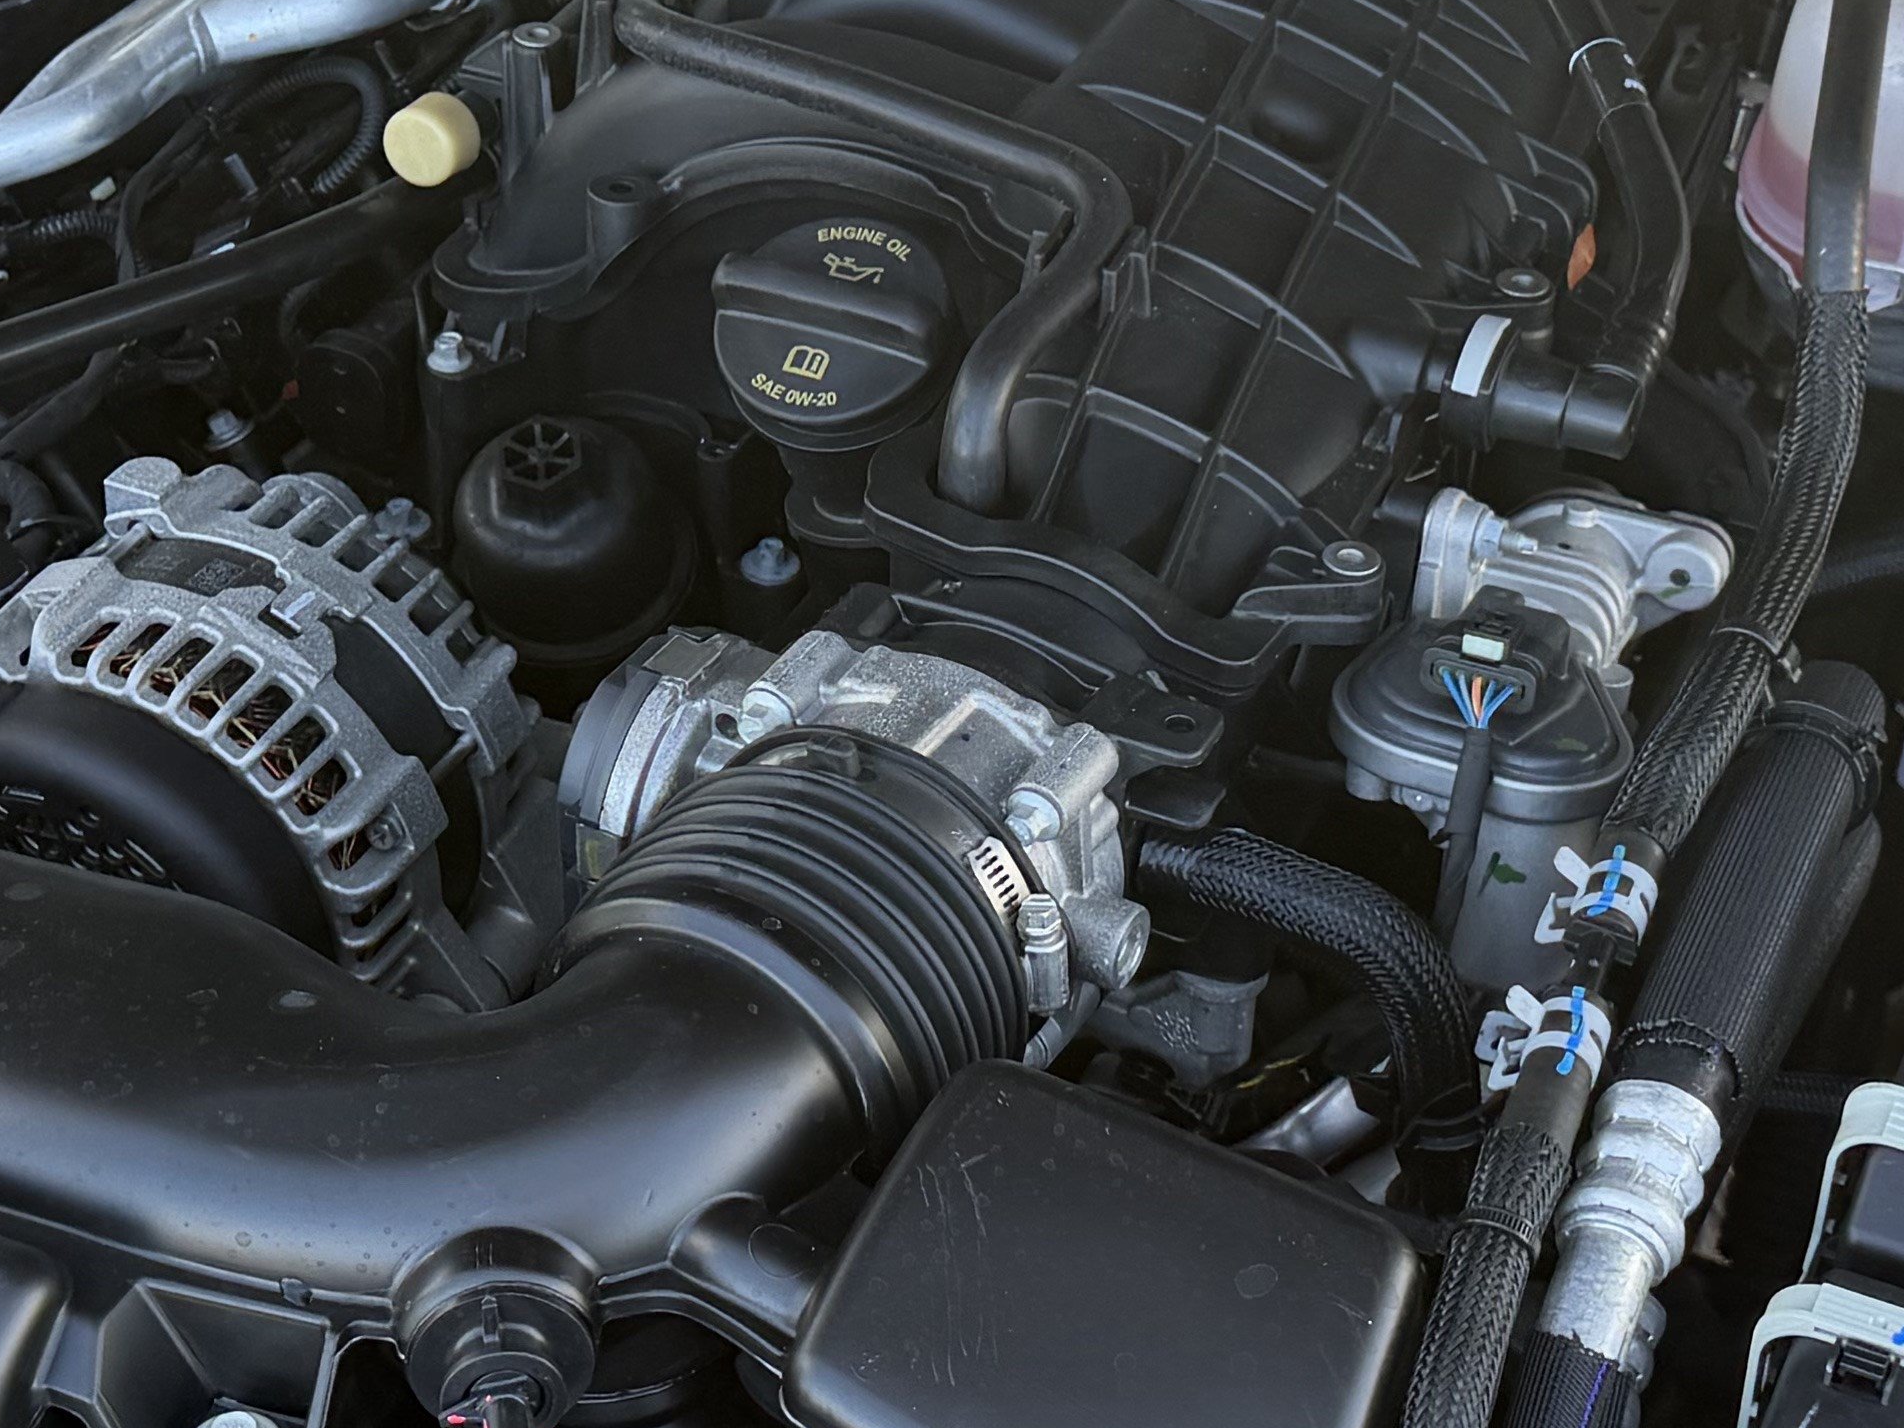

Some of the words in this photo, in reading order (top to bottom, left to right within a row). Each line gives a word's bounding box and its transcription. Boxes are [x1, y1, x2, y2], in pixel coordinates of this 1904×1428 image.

[817, 227, 887, 247] ENGINE
[885, 238, 912, 262] OIL
[751, 372, 787, 400] SAE
[785, 390, 837, 407] 0W-20
